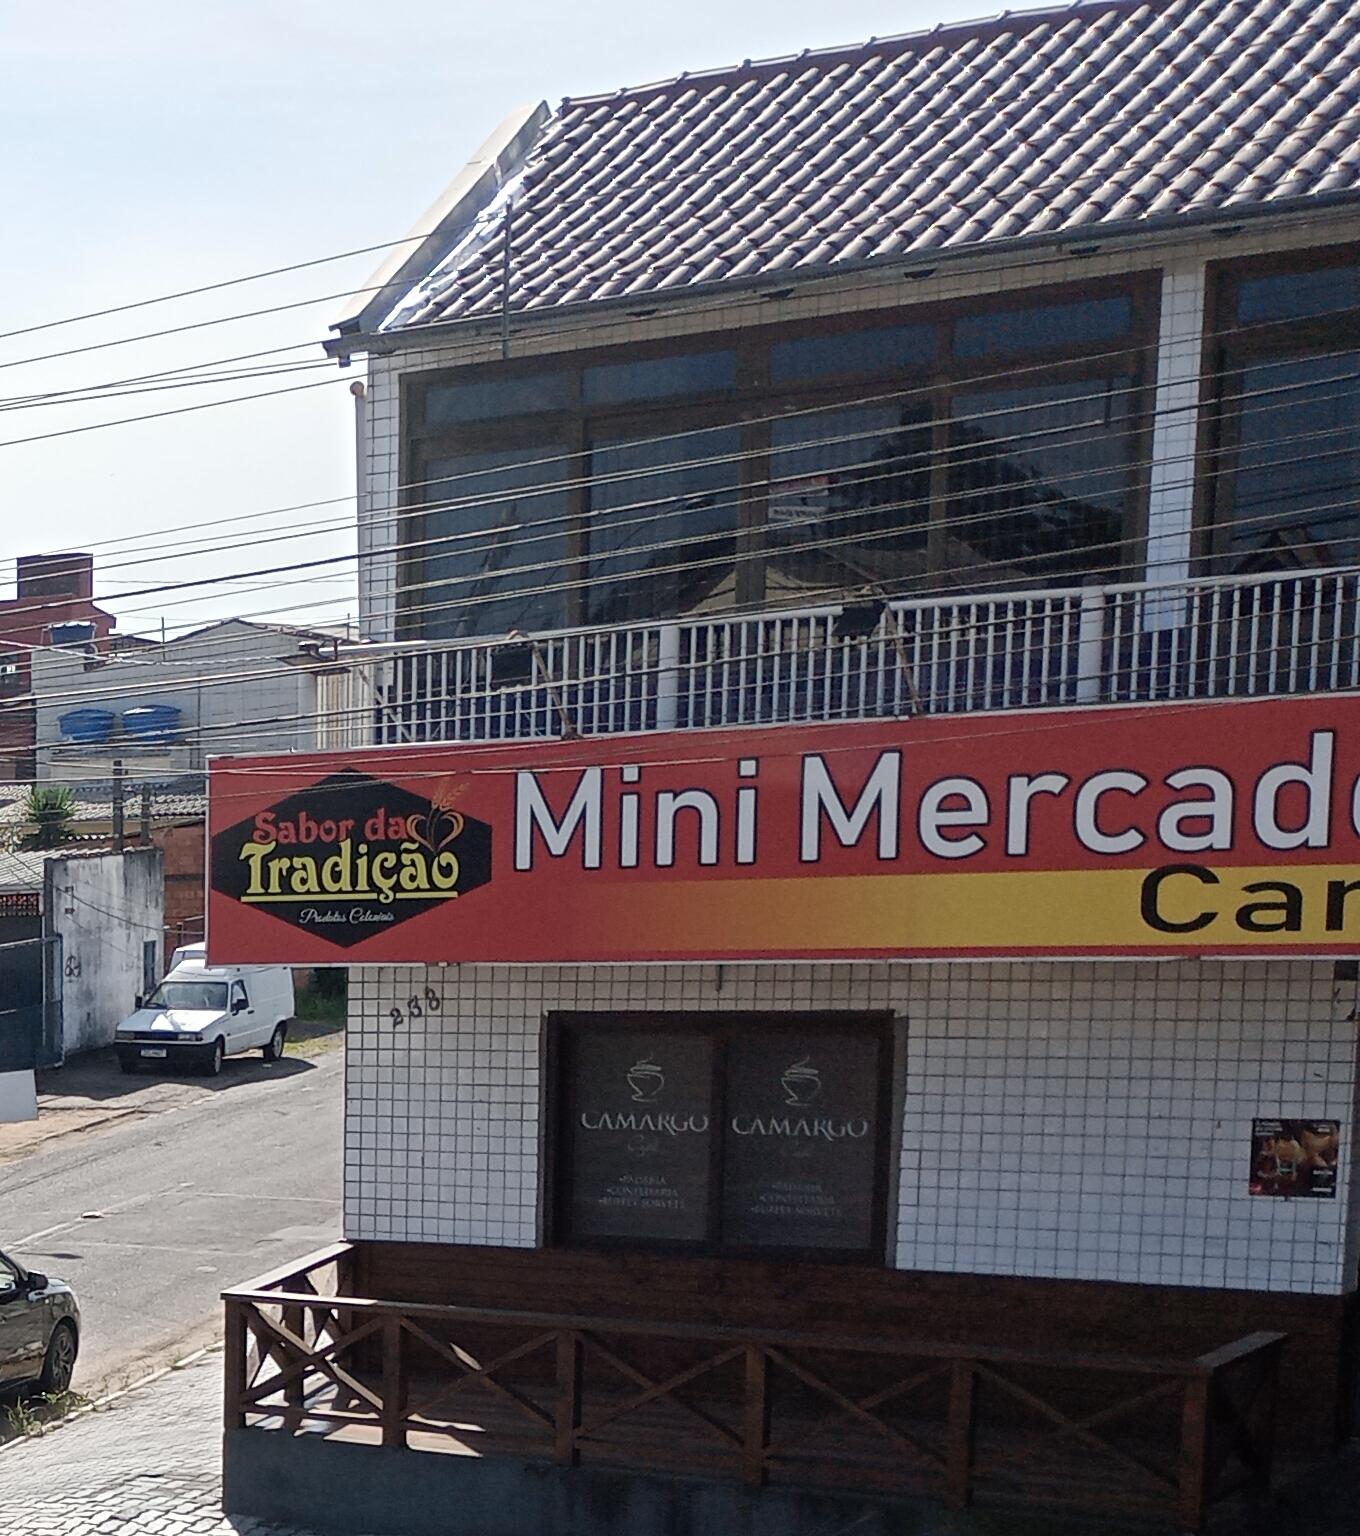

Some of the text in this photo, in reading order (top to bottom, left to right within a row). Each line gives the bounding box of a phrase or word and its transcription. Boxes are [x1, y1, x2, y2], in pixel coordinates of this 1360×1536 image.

[514, 729, 1360, 871] Mini Mercad
[252, 808, 412, 844] Sabor da
[238, 838, 459, 903] Tradição
[581, 1112, 708, 1136] CAMARGO
[732, 1116, 868, 1141] CAMARGO
